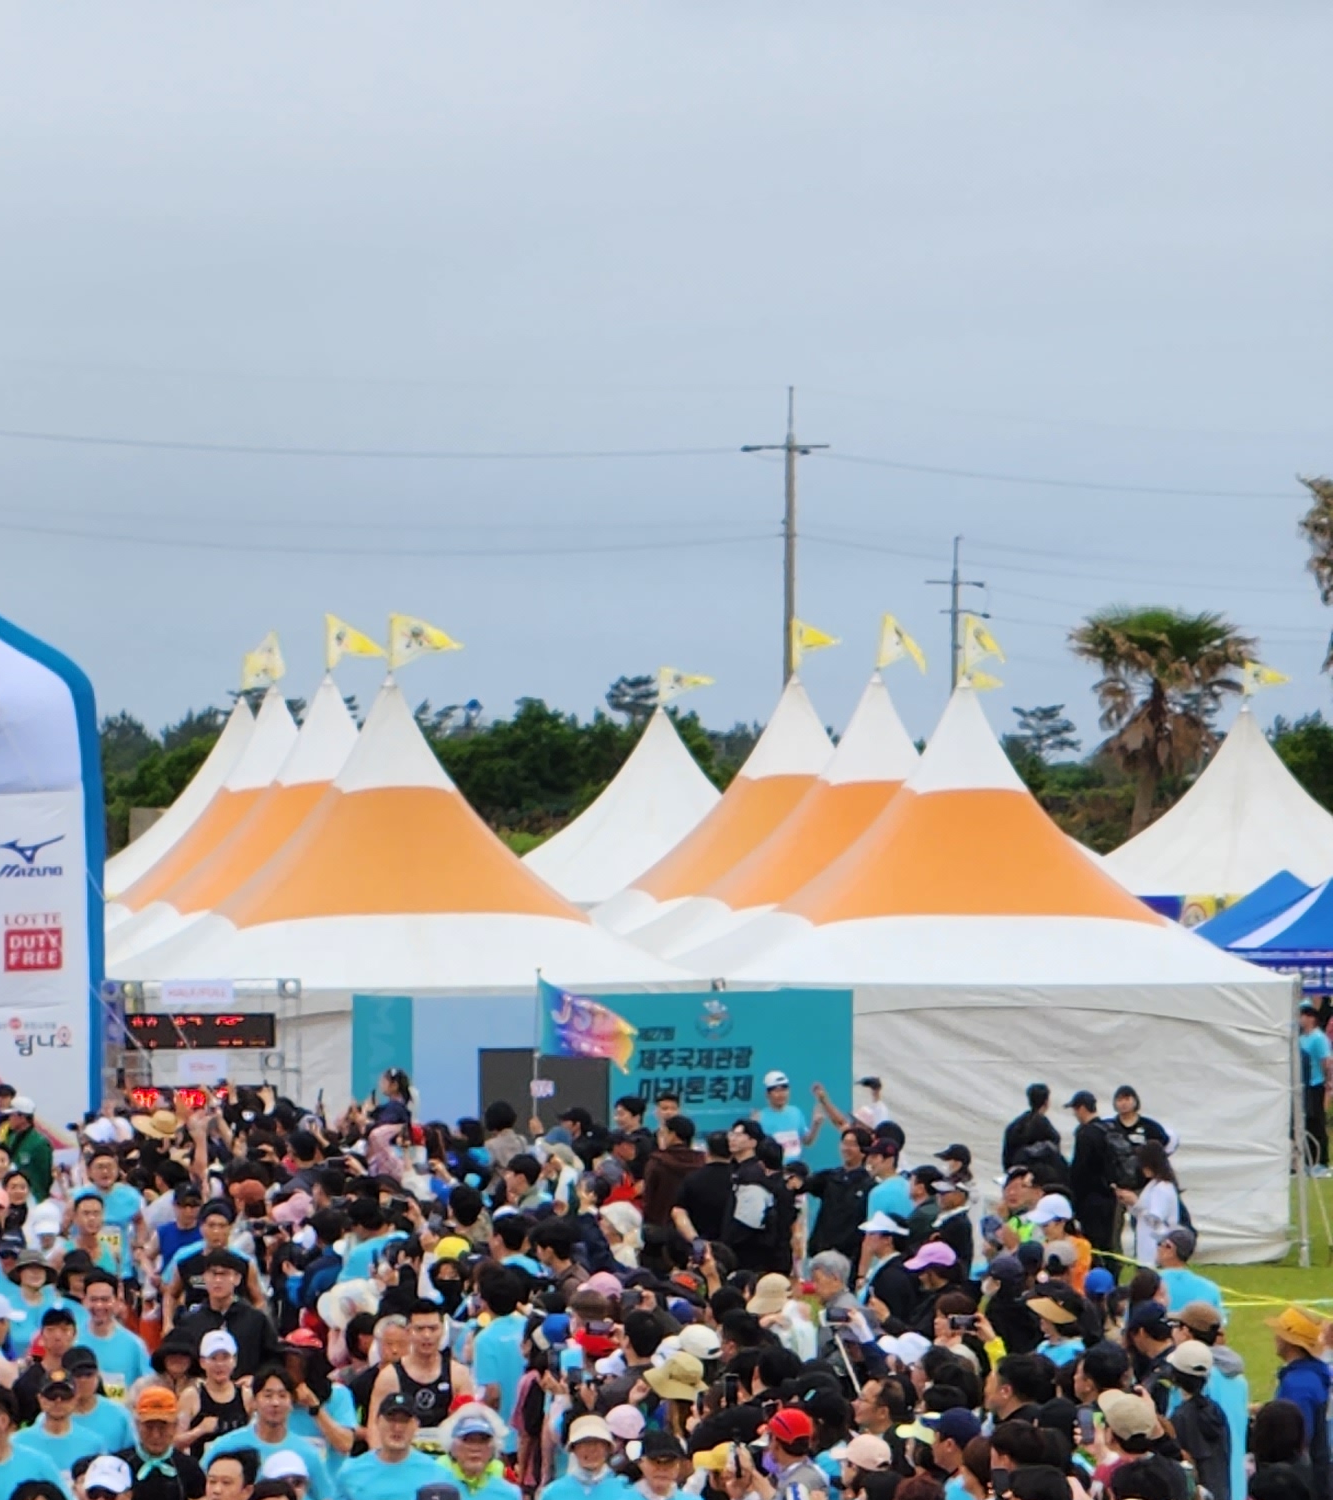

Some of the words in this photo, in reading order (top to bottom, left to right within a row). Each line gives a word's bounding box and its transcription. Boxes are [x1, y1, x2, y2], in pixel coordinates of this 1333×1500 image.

[4, 912, 62, 926] LOTTE
[9, 934, 60, 950] DUTY
[9, 951, 59, 966] FREE
[637, 1046, 753, 1072] 제주국제관광
